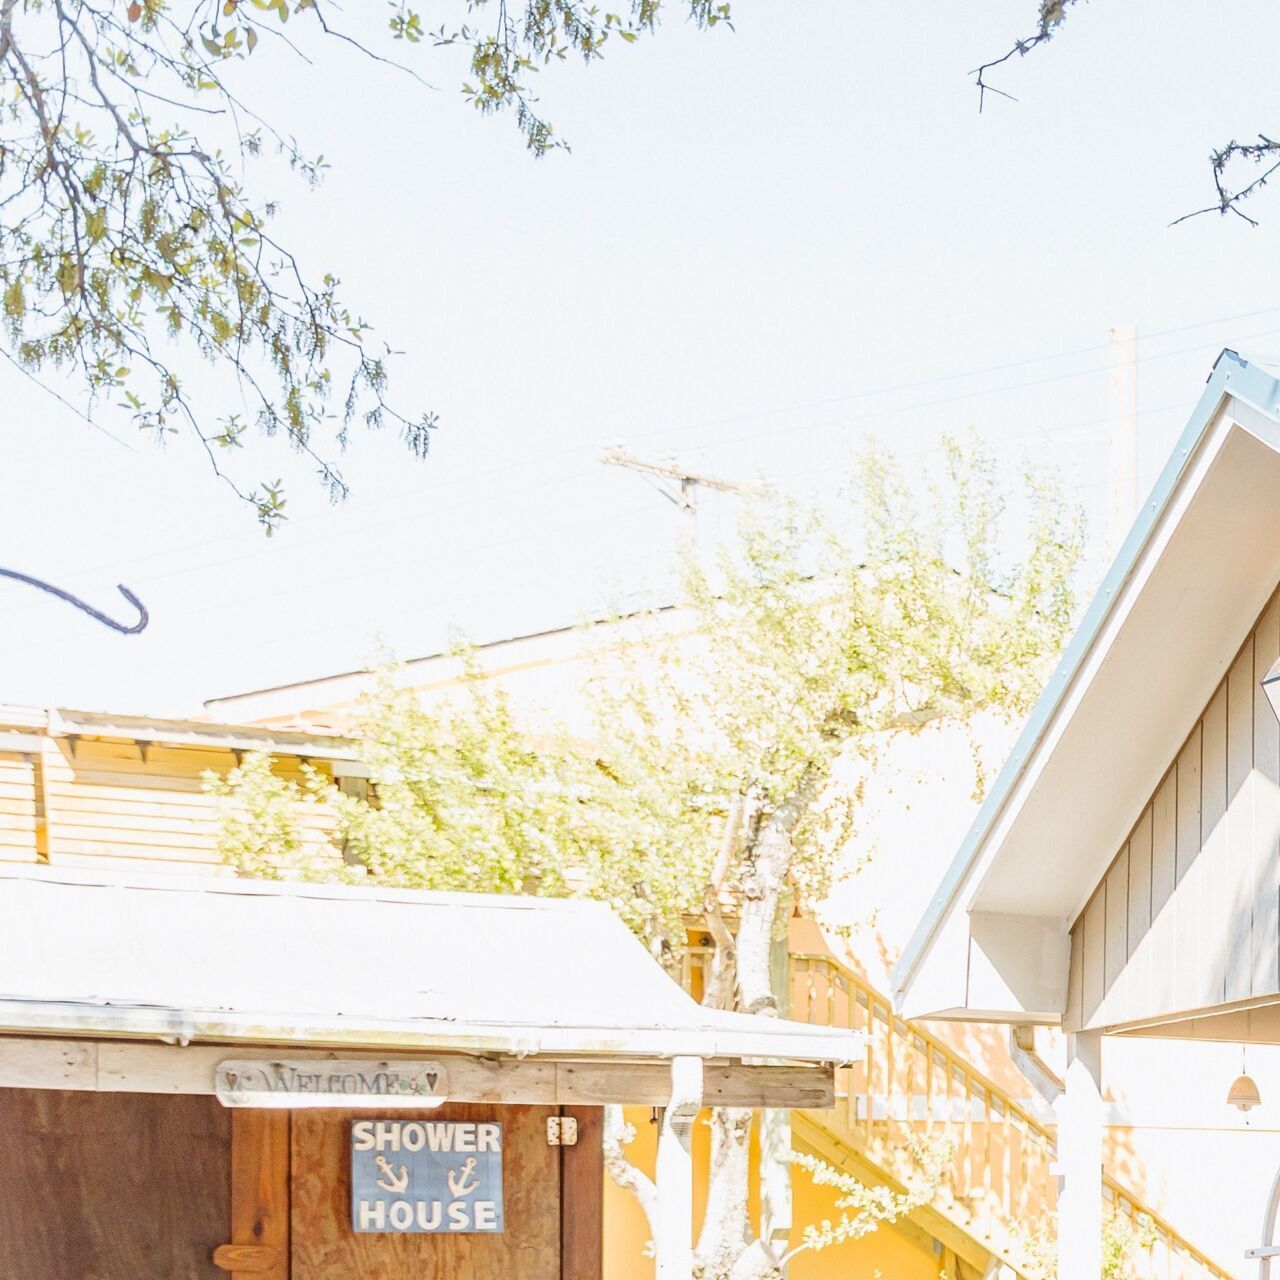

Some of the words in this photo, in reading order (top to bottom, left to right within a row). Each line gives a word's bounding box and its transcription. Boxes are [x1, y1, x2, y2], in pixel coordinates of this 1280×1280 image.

[254, 1067, 400, 1095] WELCOME
[352, 1121, 501, 1152] SHOWER
[360, 1200, 497, 1230] HOUSE
